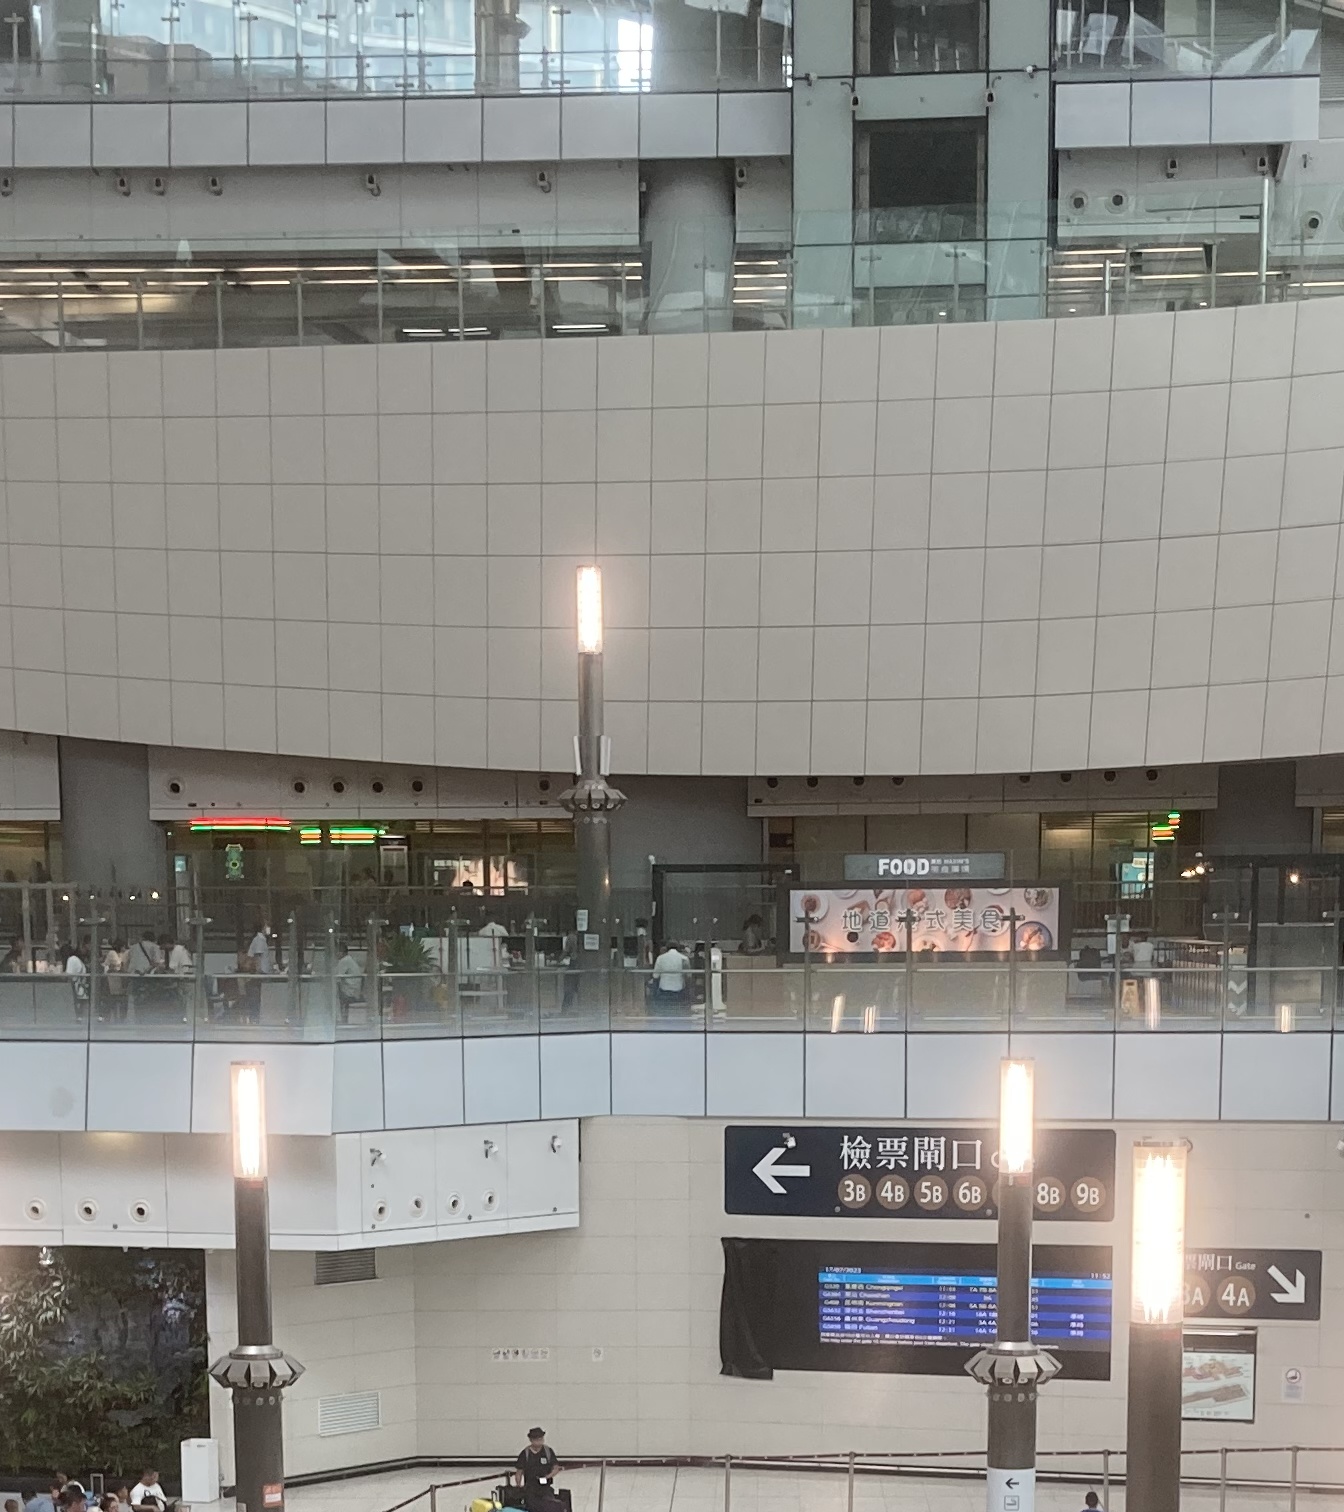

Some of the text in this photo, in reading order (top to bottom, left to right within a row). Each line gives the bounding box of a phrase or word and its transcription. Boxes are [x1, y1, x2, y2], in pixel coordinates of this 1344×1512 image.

[878, 858, 930, 875] FOOD
[839, 1135, 982, 1171] 檢票閘口
[843, 1180, 1100, 1206] 3B 4B 5B 6B 8B 9B
[1235, 1261, 1256, 1270] Gate
[1221, 1282, 1250, 1307] 4A
